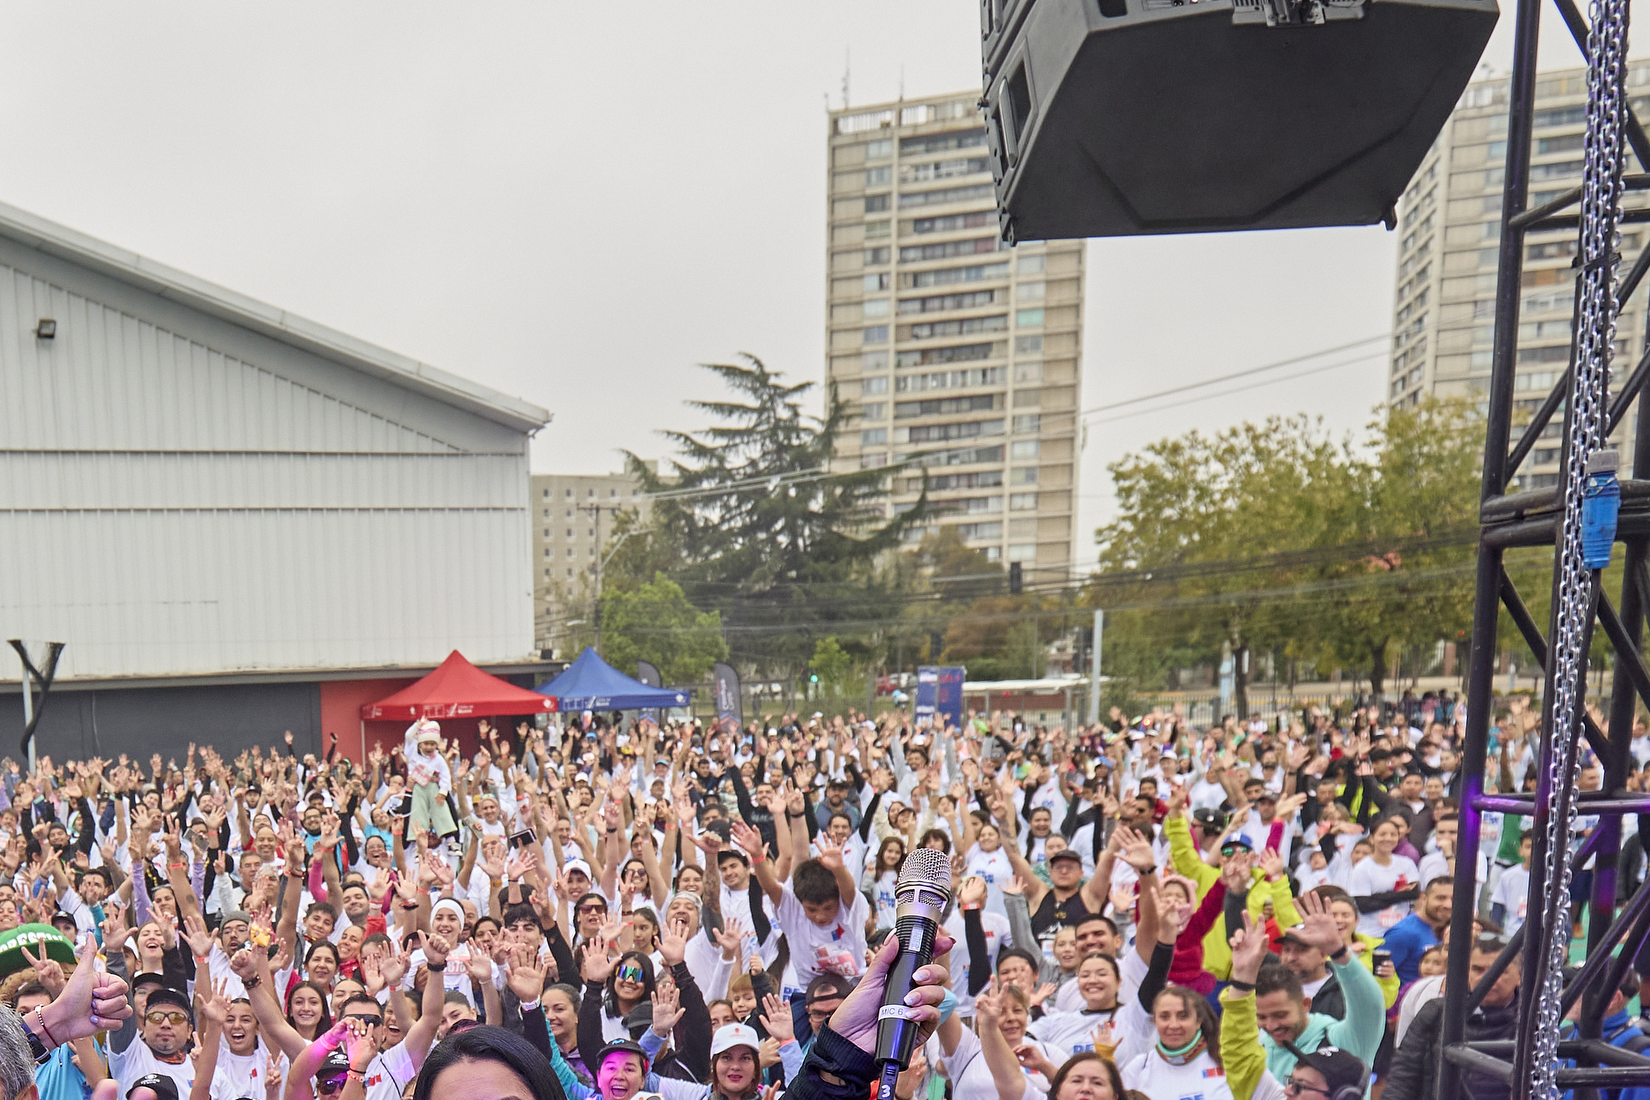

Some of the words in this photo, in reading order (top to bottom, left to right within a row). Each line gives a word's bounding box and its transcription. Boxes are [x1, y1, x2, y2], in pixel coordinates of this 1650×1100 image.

[881, 1007, 896, 1016] MIC
[898, 1007, 904, 1015] 6
[881, 1084, 891, 1098] 3
